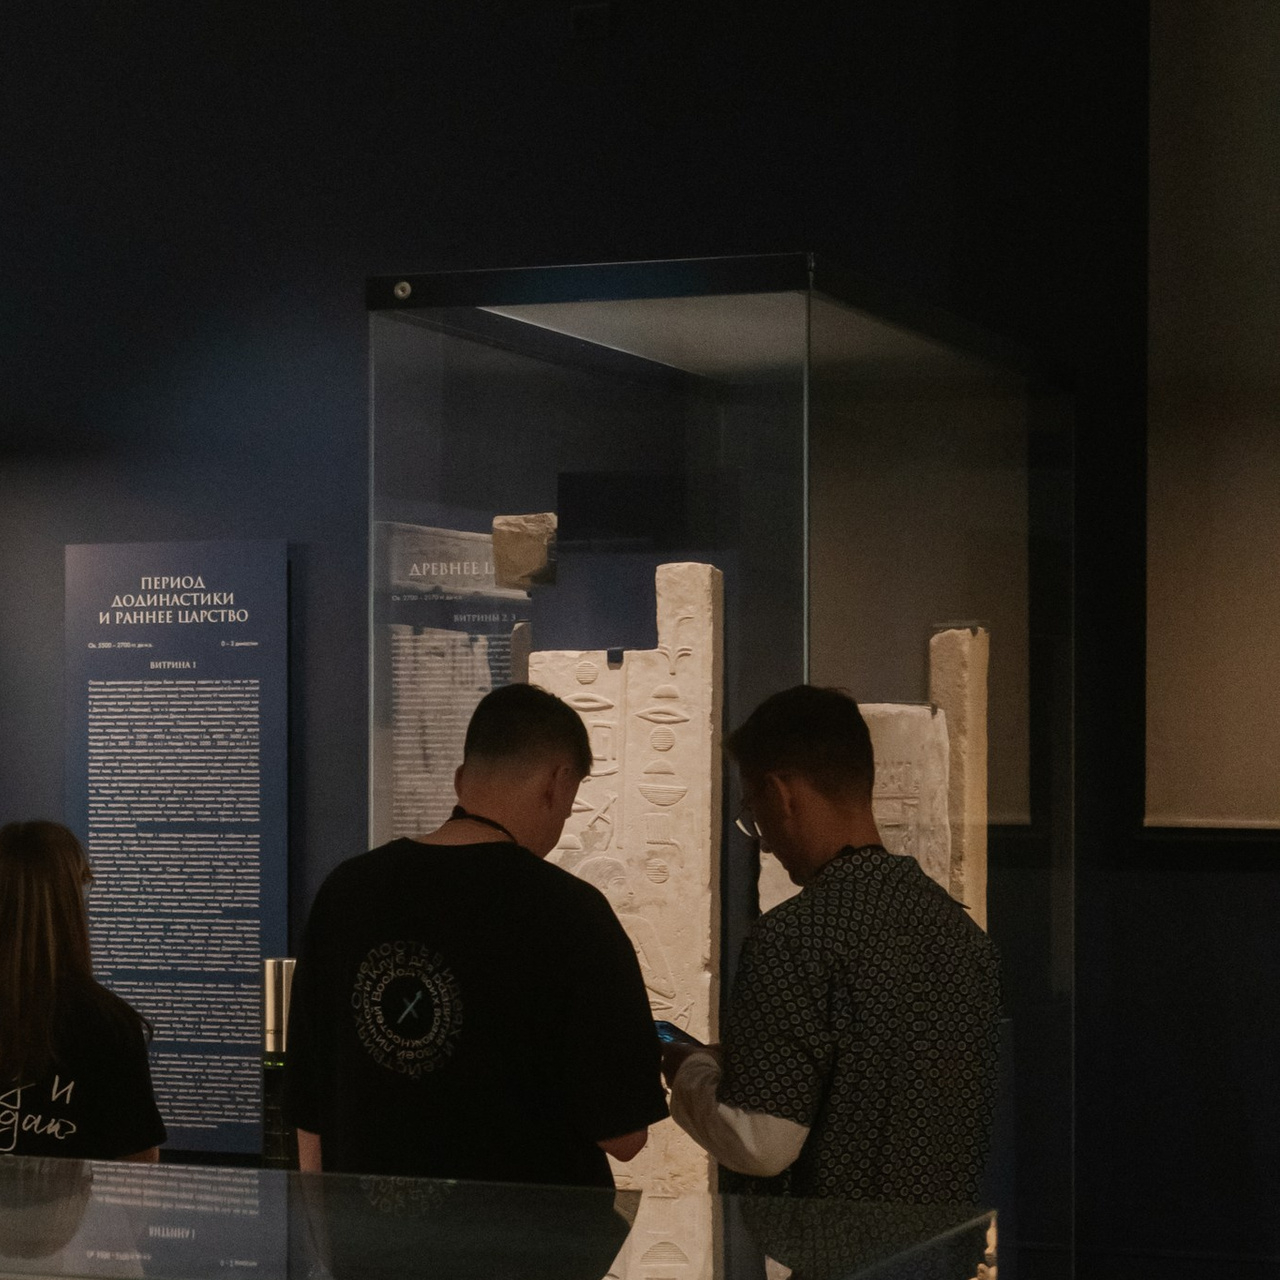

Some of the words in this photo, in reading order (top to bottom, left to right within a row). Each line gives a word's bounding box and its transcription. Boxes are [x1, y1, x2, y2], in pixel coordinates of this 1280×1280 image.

[409, 561, 480, 576] ДРЕВНЕЕ
[141, 576, 206, 590] ПЕРИОД
[111, 592, 234, 608] ДОДИНАСТИКИ
[99, 611, 110, 625] И
[115, 610, 173, 625] РАННЕЕ
[178, 609, 249, 623] ЦАРСТВО
[150, 661, 191, 670] ВИТРИНА
